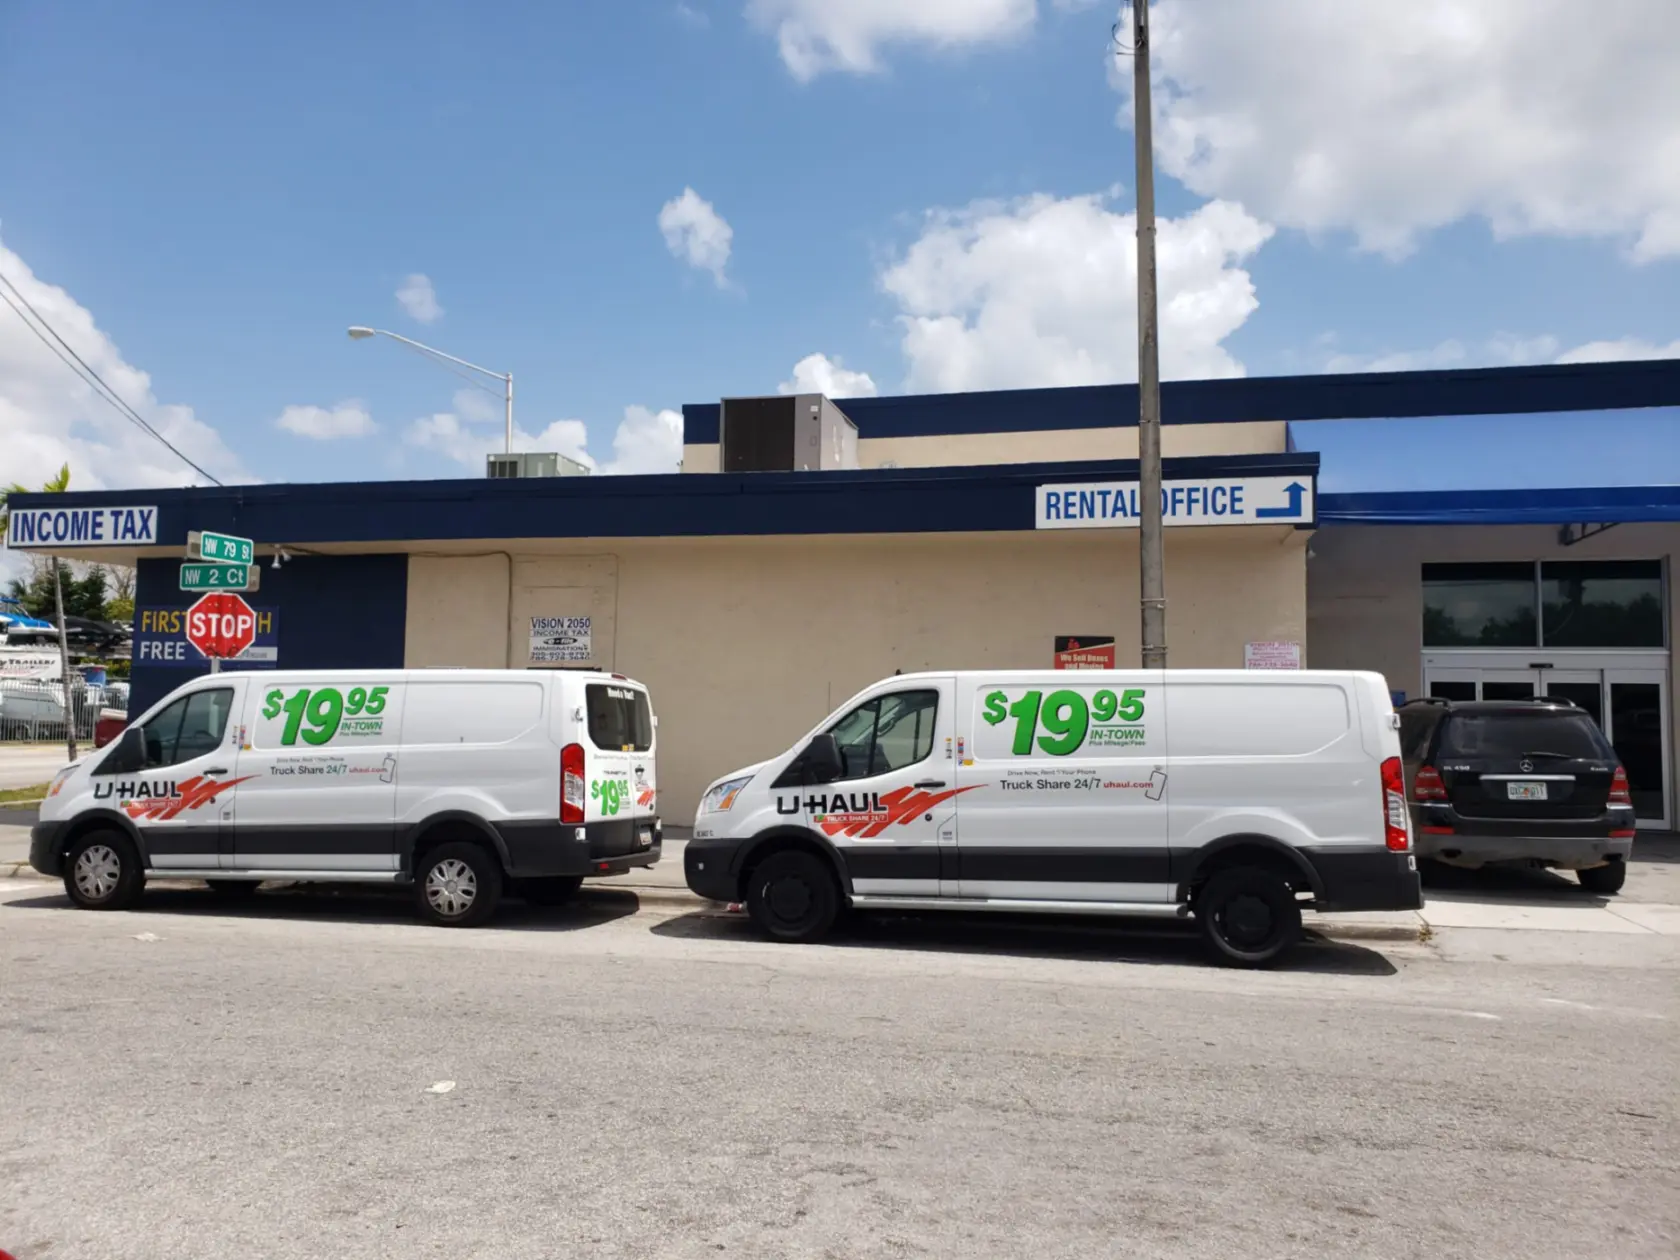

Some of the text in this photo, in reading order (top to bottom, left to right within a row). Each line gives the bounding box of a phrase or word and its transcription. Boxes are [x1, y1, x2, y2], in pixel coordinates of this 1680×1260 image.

[1045, 489, 1141, 520] RENTAL
[13, 508, 153, 543] INCOME TAX
[204, 537, 250, 560] NW 79 St
[185, 568, 244, 585] NW 2 Ct
[191, 612, 252, 639] STOP
[531, 617, 591, 629] VISION 2050
[533, 629, 590, 637] INCOME TAX
[140, 641, 186, 660] FREE
[340, 721, 383, 731] IN-TOWN
[1090, 729, 1145, 740] IN-TOWN
[270, 764, 348, 776] Truck Share 24/7
[94, 781, 182, 799] U-HAUL
[1000, 778, 1101, 791] Truck Share 24/7
[1103, 781, 1154, 789] uhaul.com
[777, 792, 888, 815] U-HAUL
